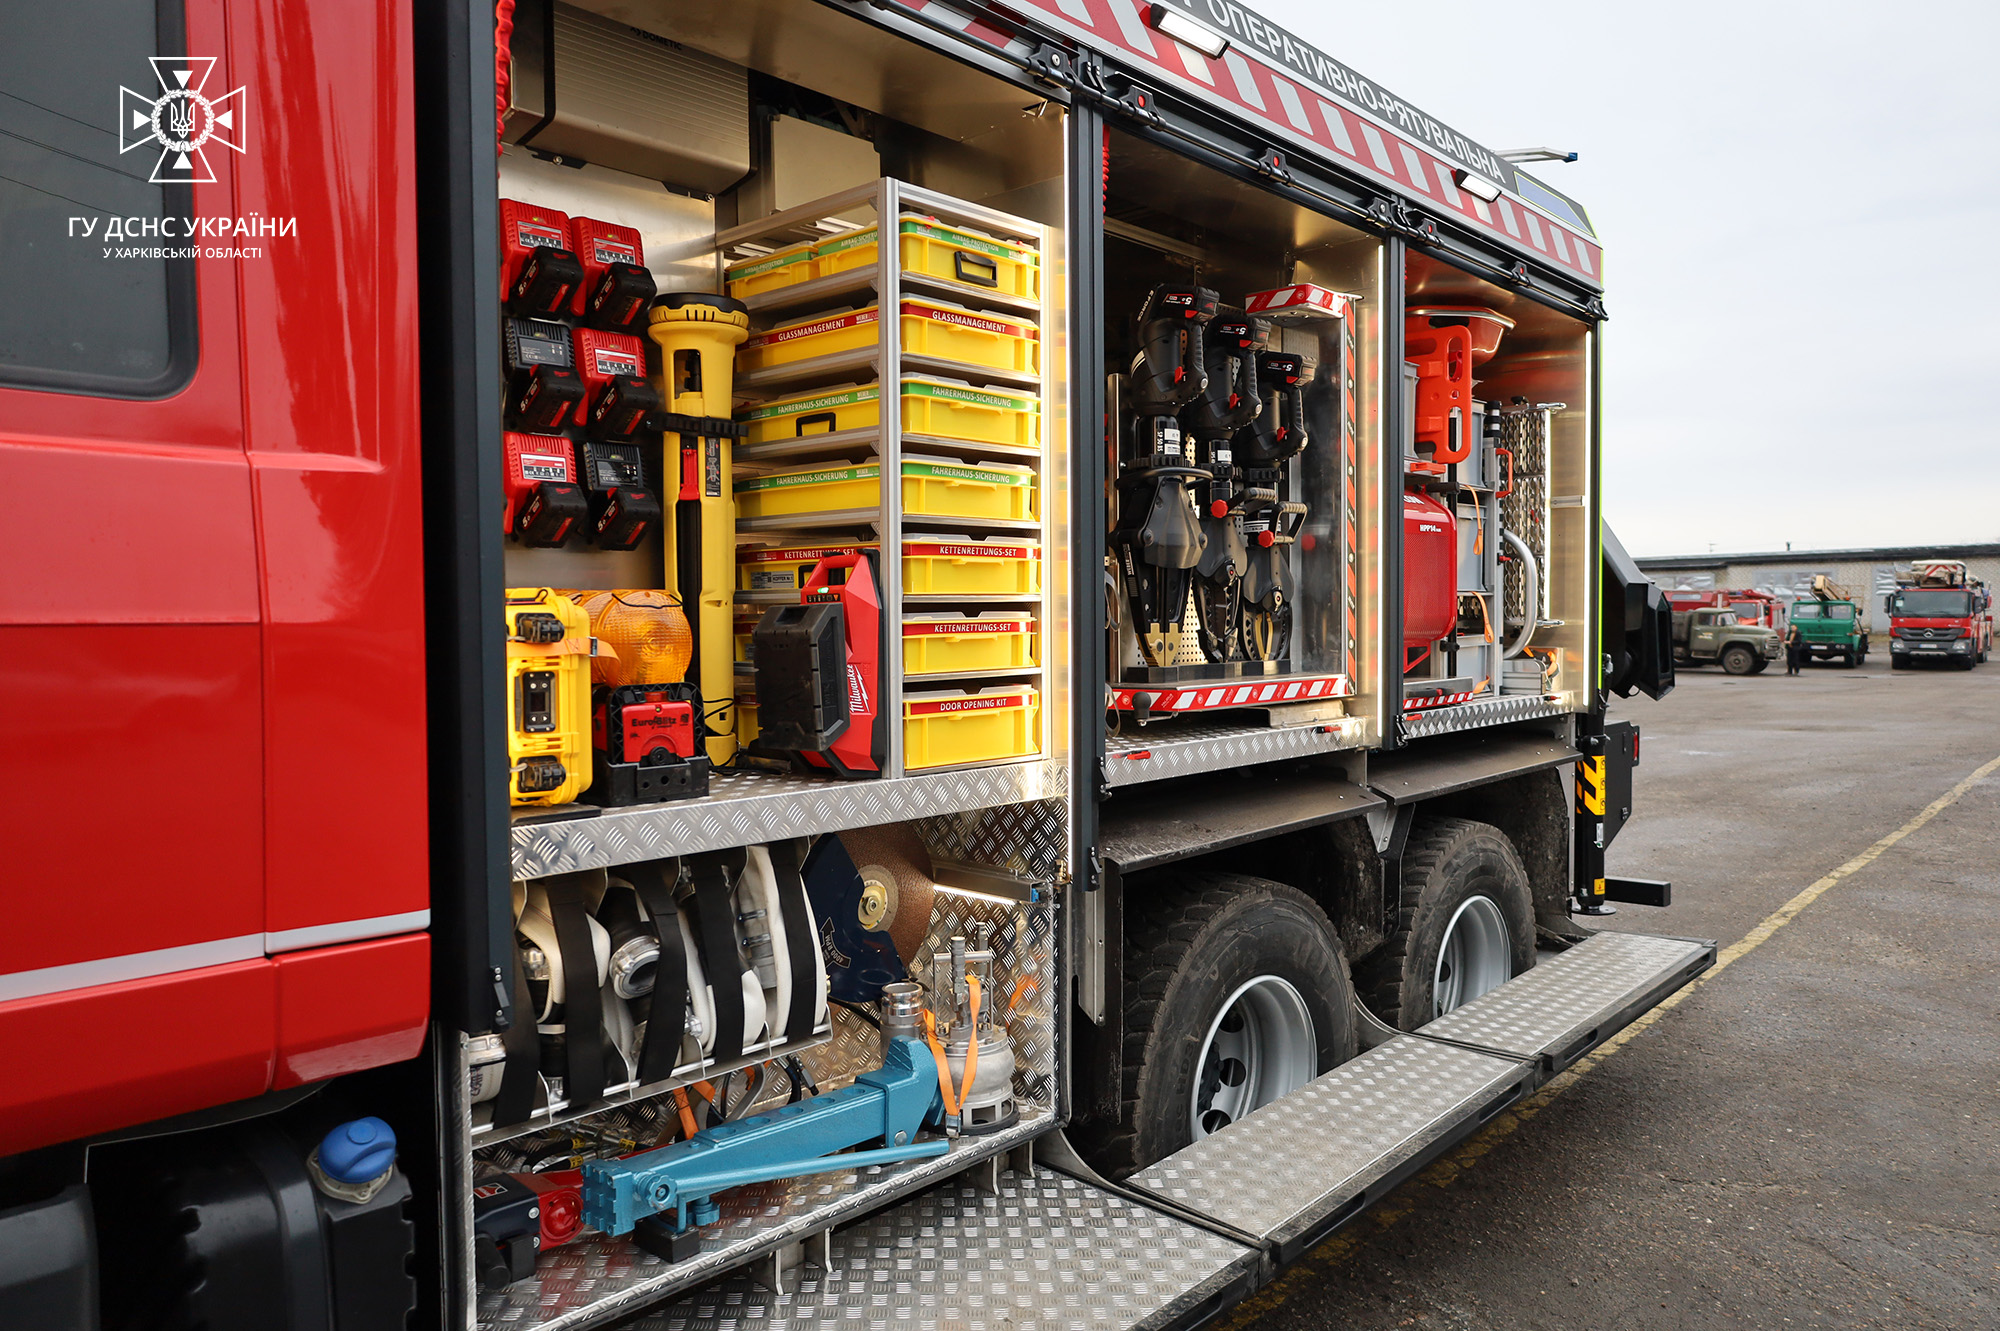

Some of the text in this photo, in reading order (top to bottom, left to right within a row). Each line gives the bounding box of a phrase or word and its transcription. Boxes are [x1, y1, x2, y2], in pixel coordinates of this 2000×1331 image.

[1207, 0, 1506, 184] ОПЕРАТИВНО-РЯТУВАЛЬНА
[841, 231, 877, 247] AIRBAG-SICHERU
[778, 319, 845, 341] GLASSMANAGEMENT
[932, 311, 1006, 333] GLASSMANAGEMENT
[778, 394, 849, 414] FAHRERHAUS-SICHERUNG
[932, 386, 1012, 407] FAHRERHAUS-SICHERUNG
[776, 470, 848, 486] FAHRERHAUS-SICHERUNG
[931, 466, 1010, 483] FAHRERHAUS-SICHERUNG
[784, 548, 854, 559] KETTENRETTSET
[939, 545, 1017, 557] KETTENRETTUNGS-SET
[934, 623, 1011, 633] KETTENRETTUNGS-SET
[847, 664, 865, 712] Milwaukee
[940, 698, 1007, 711] DOOR OPENING KIT
[825, 935, 833, 951] RPM
